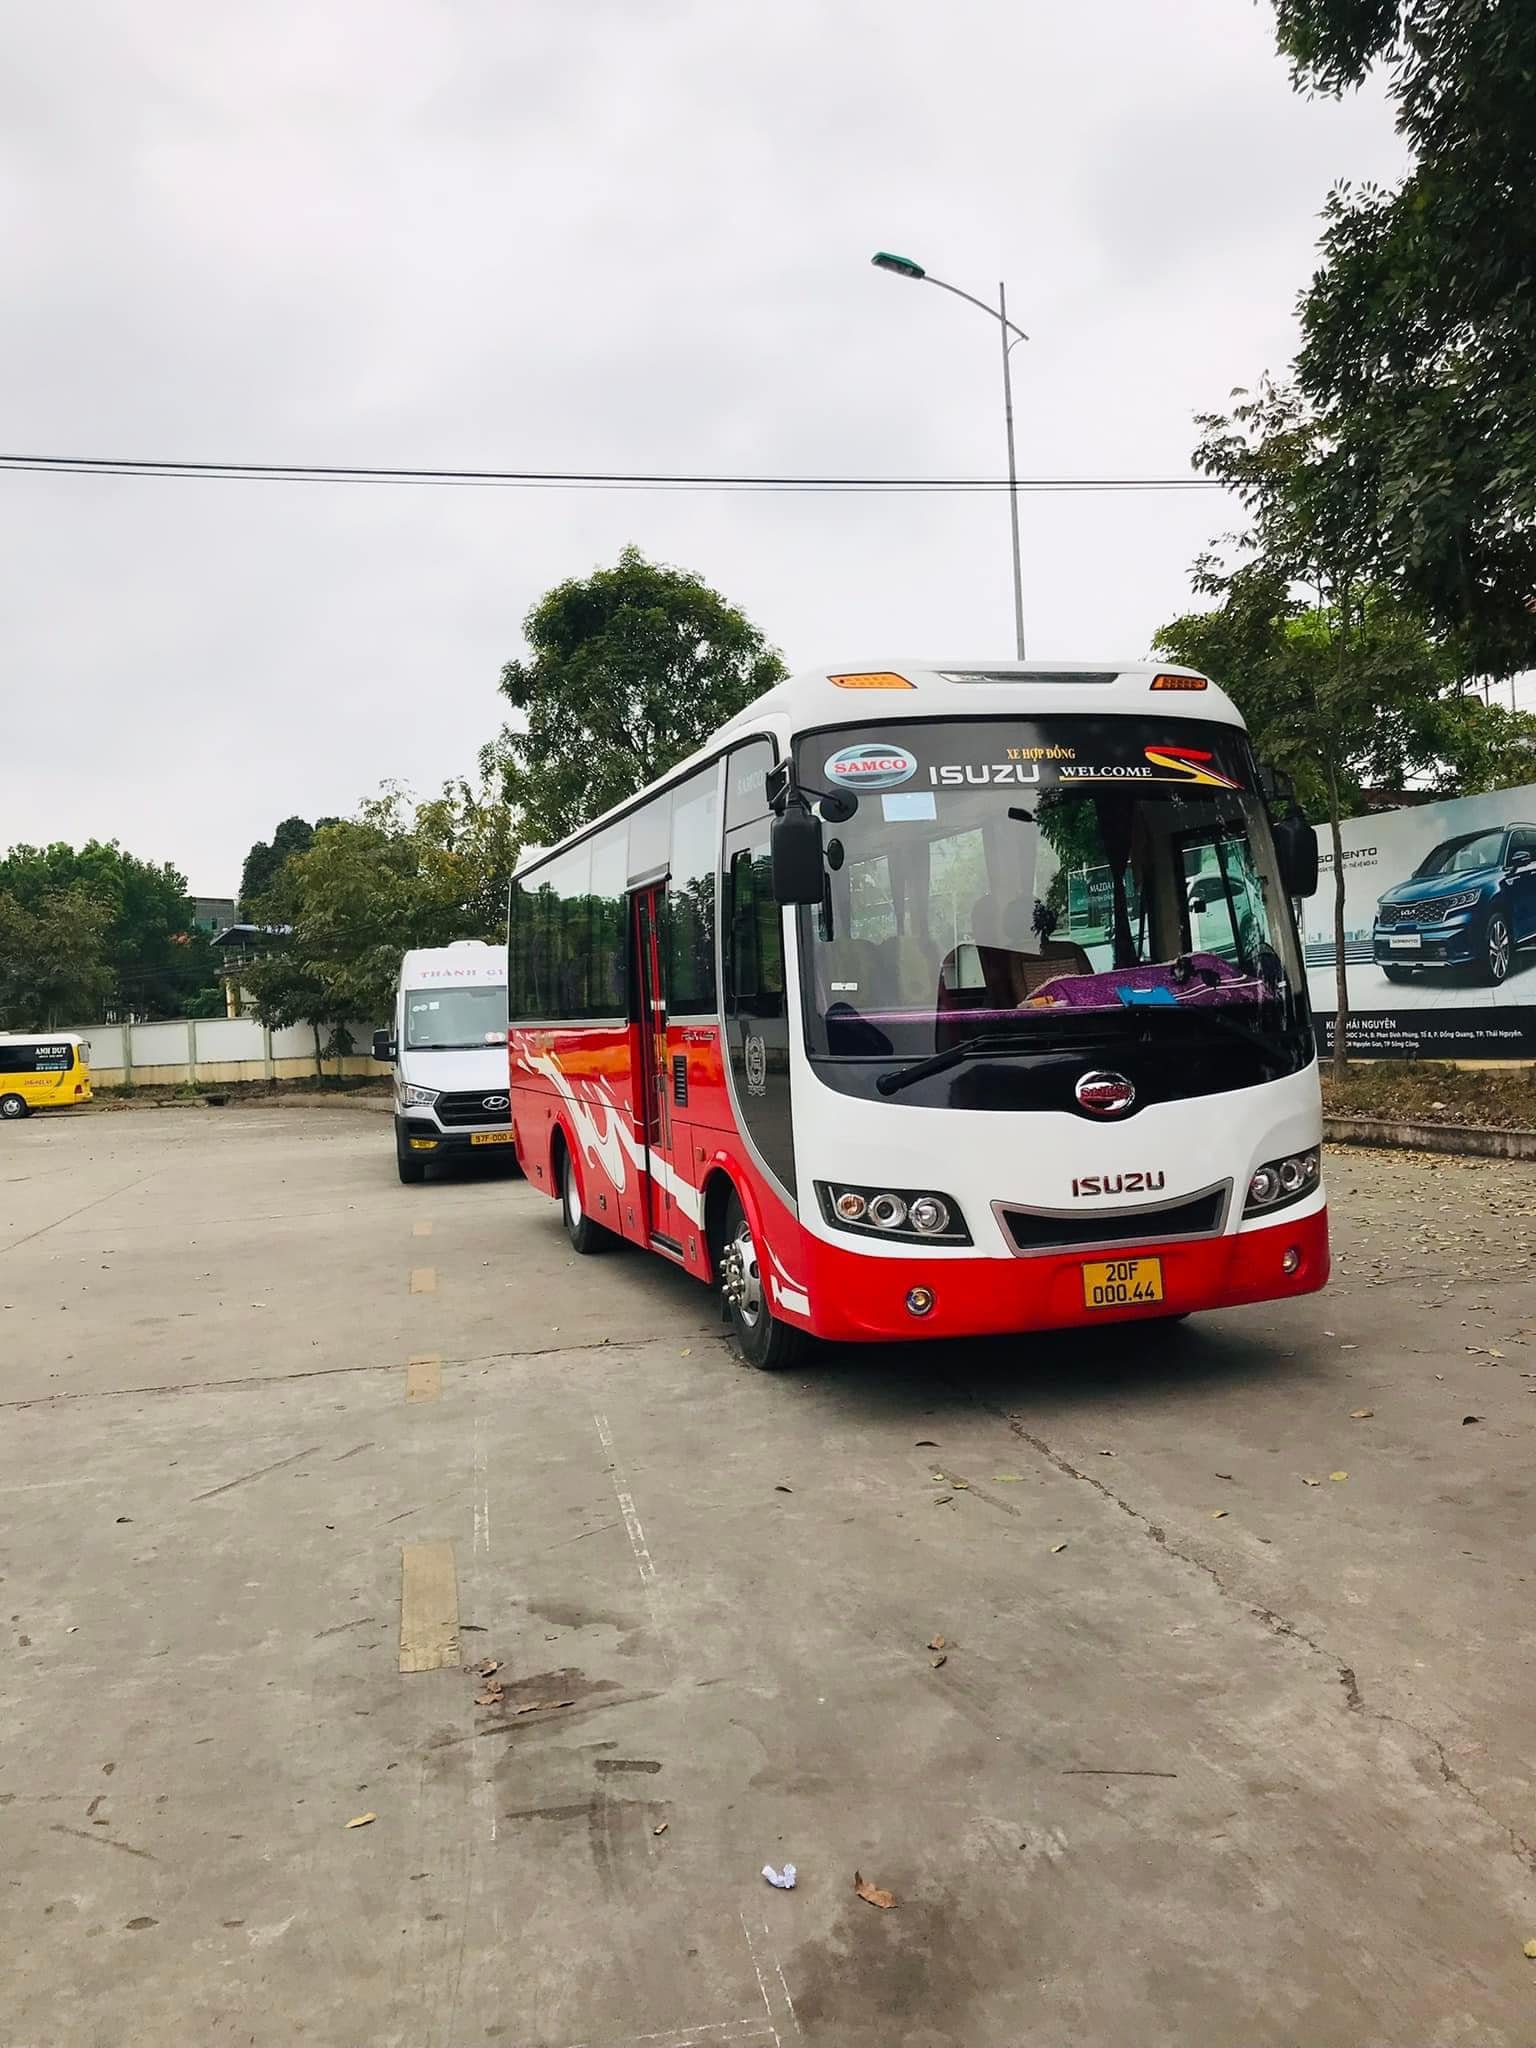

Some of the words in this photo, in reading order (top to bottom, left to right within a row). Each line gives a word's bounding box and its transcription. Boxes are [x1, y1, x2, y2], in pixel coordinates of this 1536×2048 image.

[1006, 747, 1021, 760] XE
[1022, 747, 1044, 762] HỢP
[833, 756, 908, 775] SAMCO
[929, 763, 1041, 785] ISUZU
[1060, 765, 1153, 778] WELCOME
[1316, 847, 1378, 864] SOENTO
[1346, 1018, 1360, 1030] HÁI
[1361, 1017, 1396, 1029] NGUYÊN
[1072, 1170, 1165, 1197] ISUZU
[1106, 1262, 1139, 1281] 20F
[1093, 1281, 1155, 1304] 000.44
